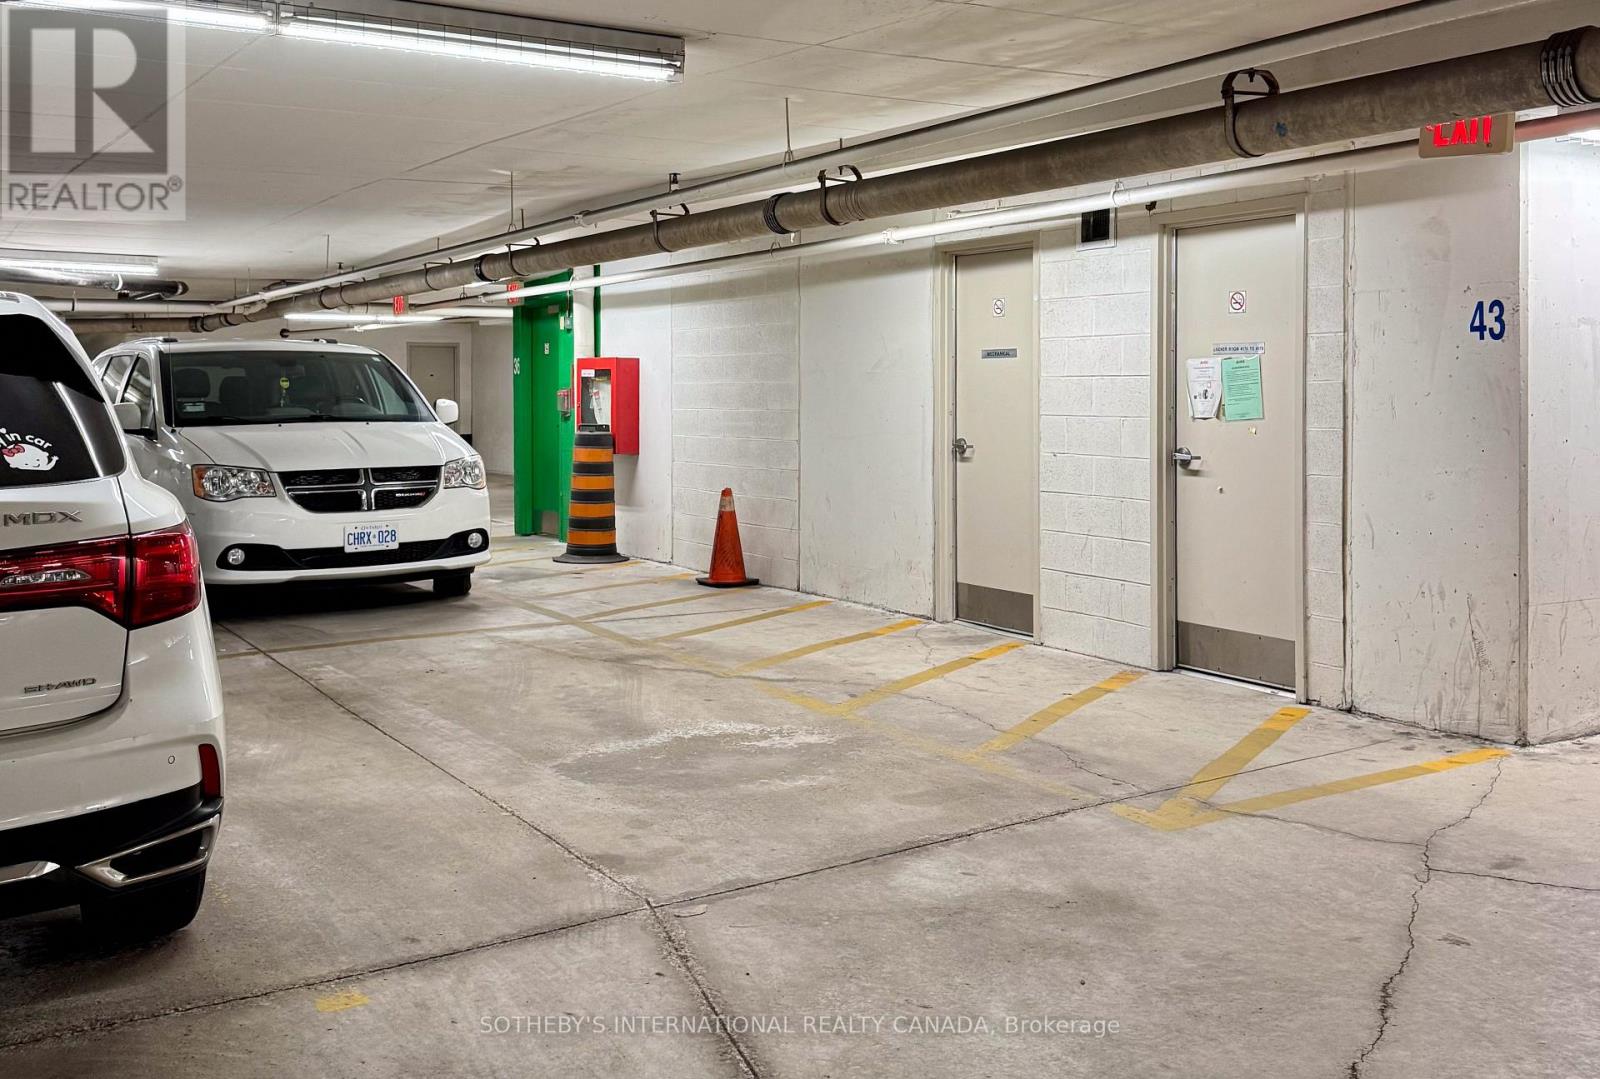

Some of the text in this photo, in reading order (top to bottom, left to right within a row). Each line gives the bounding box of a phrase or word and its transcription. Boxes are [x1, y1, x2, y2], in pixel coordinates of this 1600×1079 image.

[1470, 300, 1506, 340] 43
[25, 434, 52, 449] car
[4, 510, 82, 527] MDX
[347, 529, 397, 546] CHRX 028
